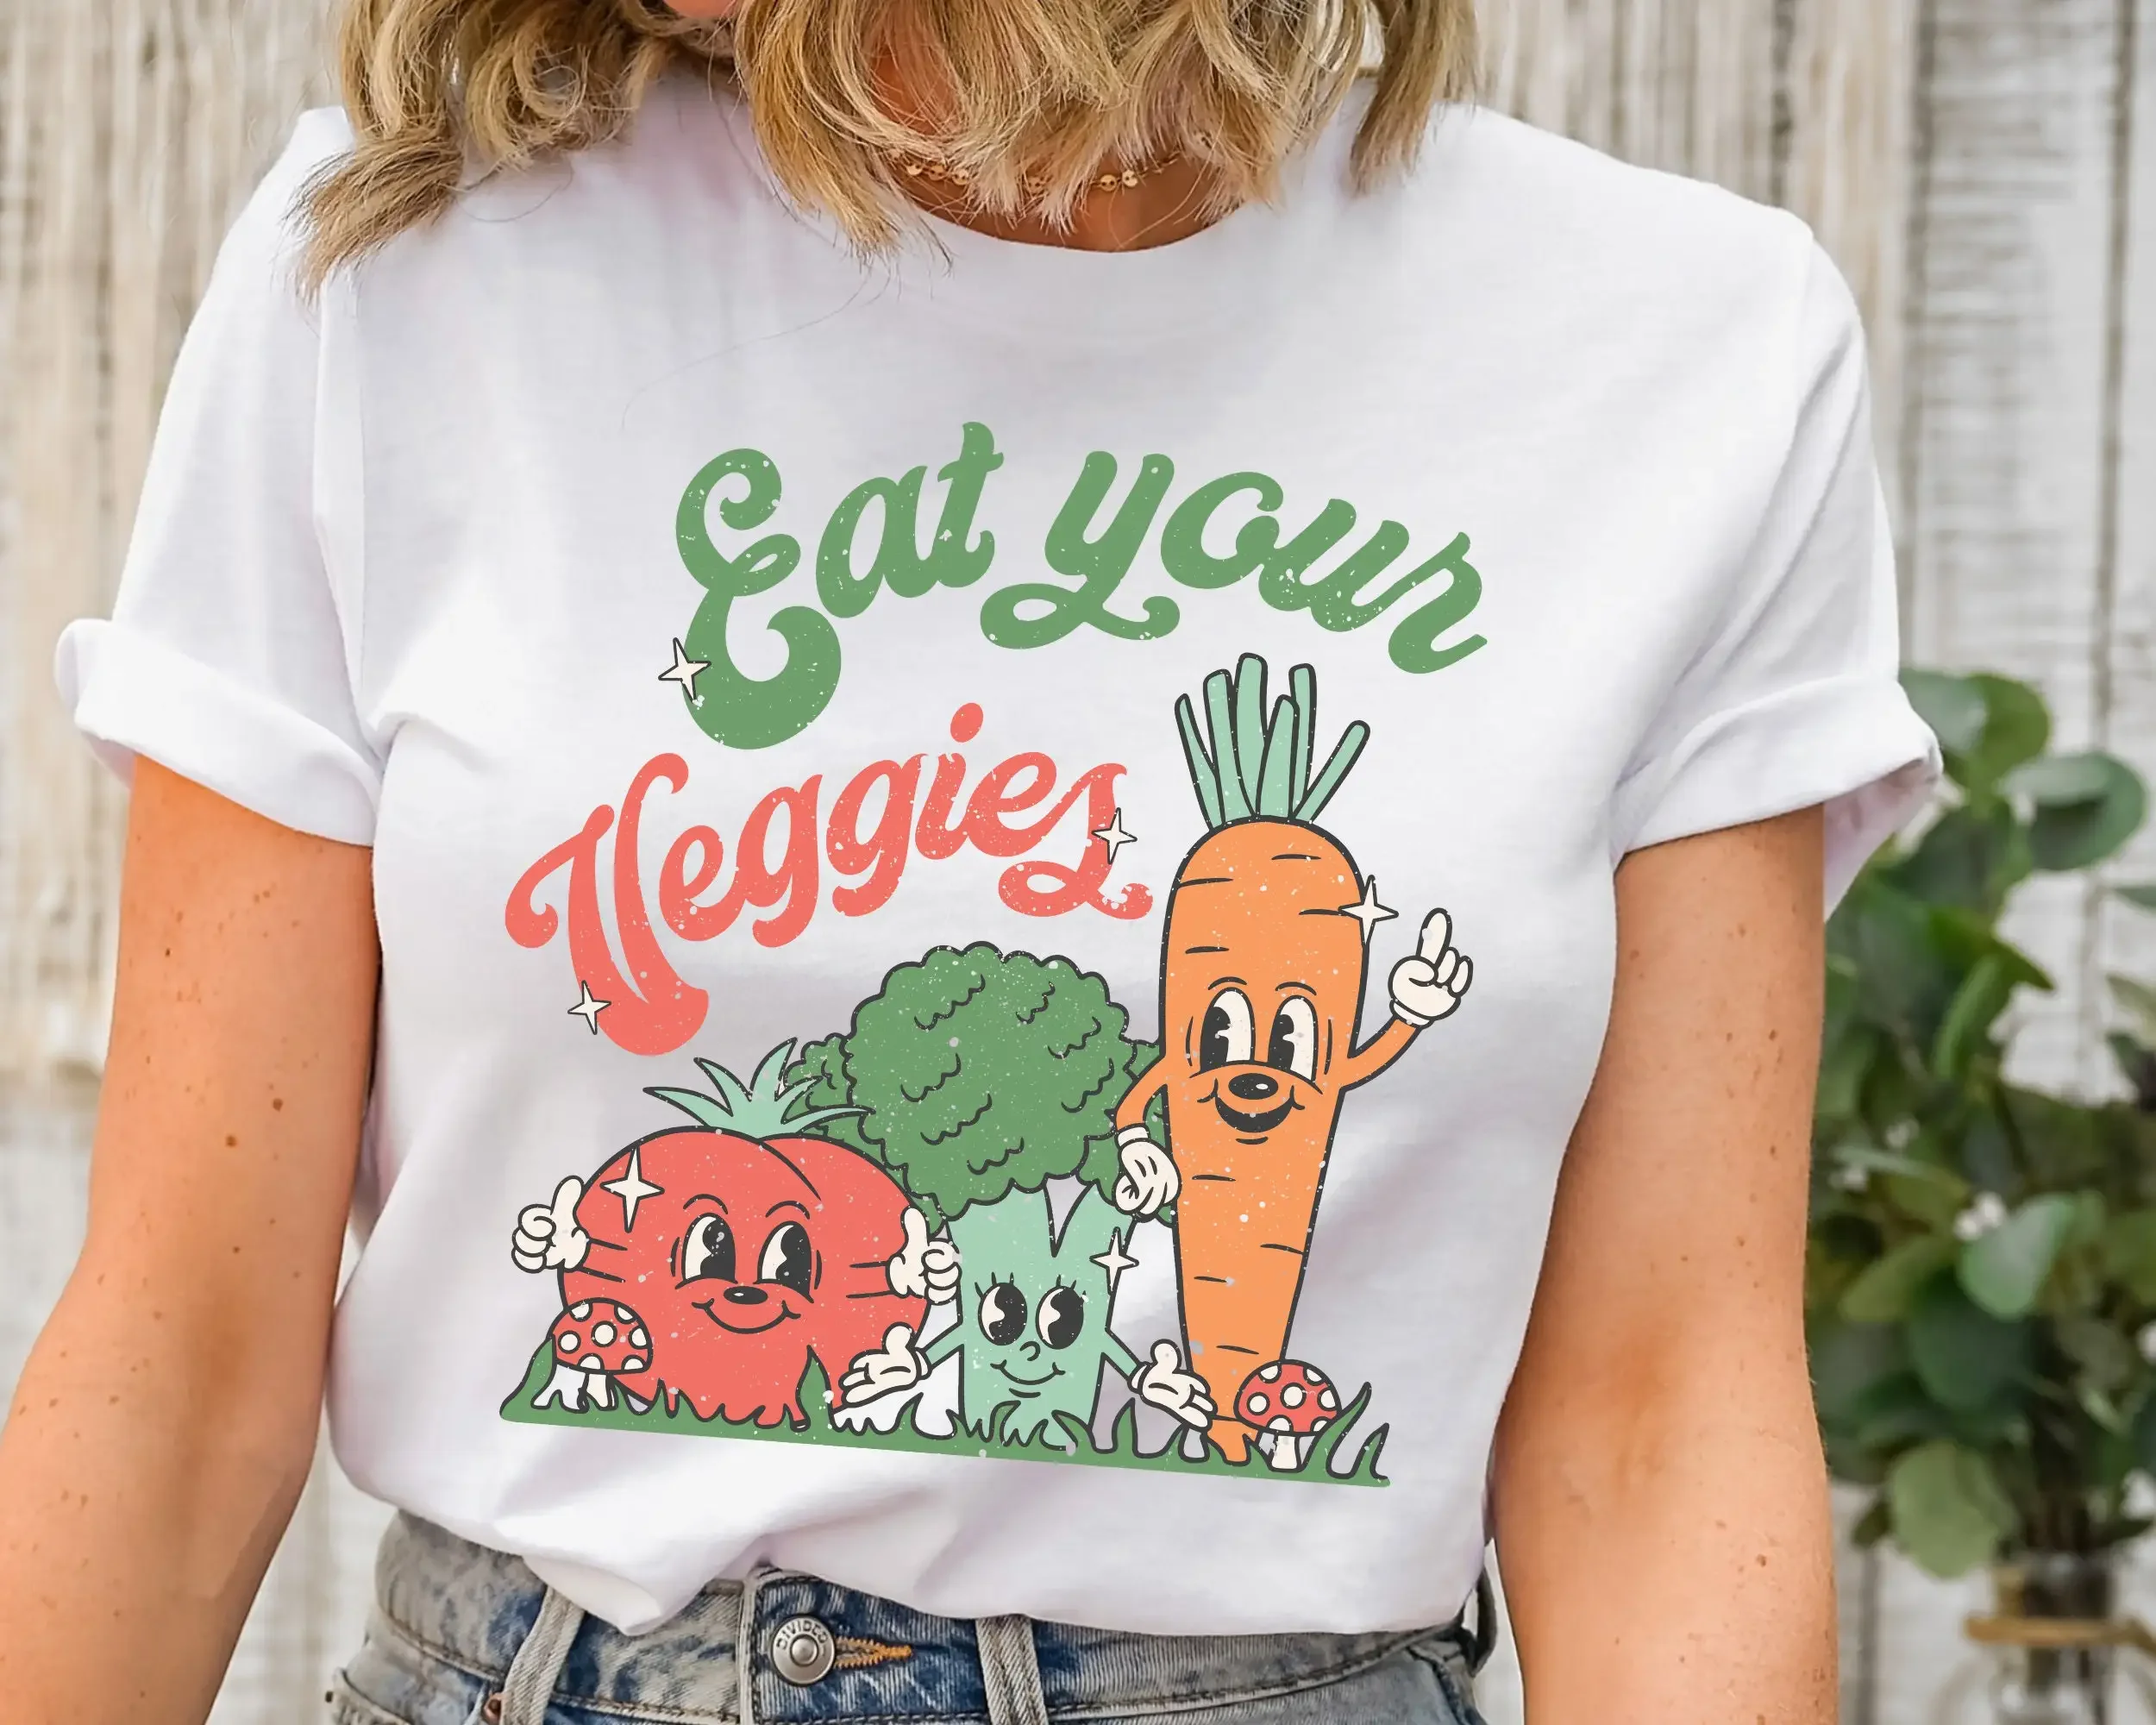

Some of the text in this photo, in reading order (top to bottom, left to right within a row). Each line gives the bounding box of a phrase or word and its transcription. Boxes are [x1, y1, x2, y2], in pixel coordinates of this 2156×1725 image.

[676, 422, 1488, 750] Eat your
[505, 703, 1152, 1057] Veggies
[775, 1619, 829, 1651] DIVIDED
